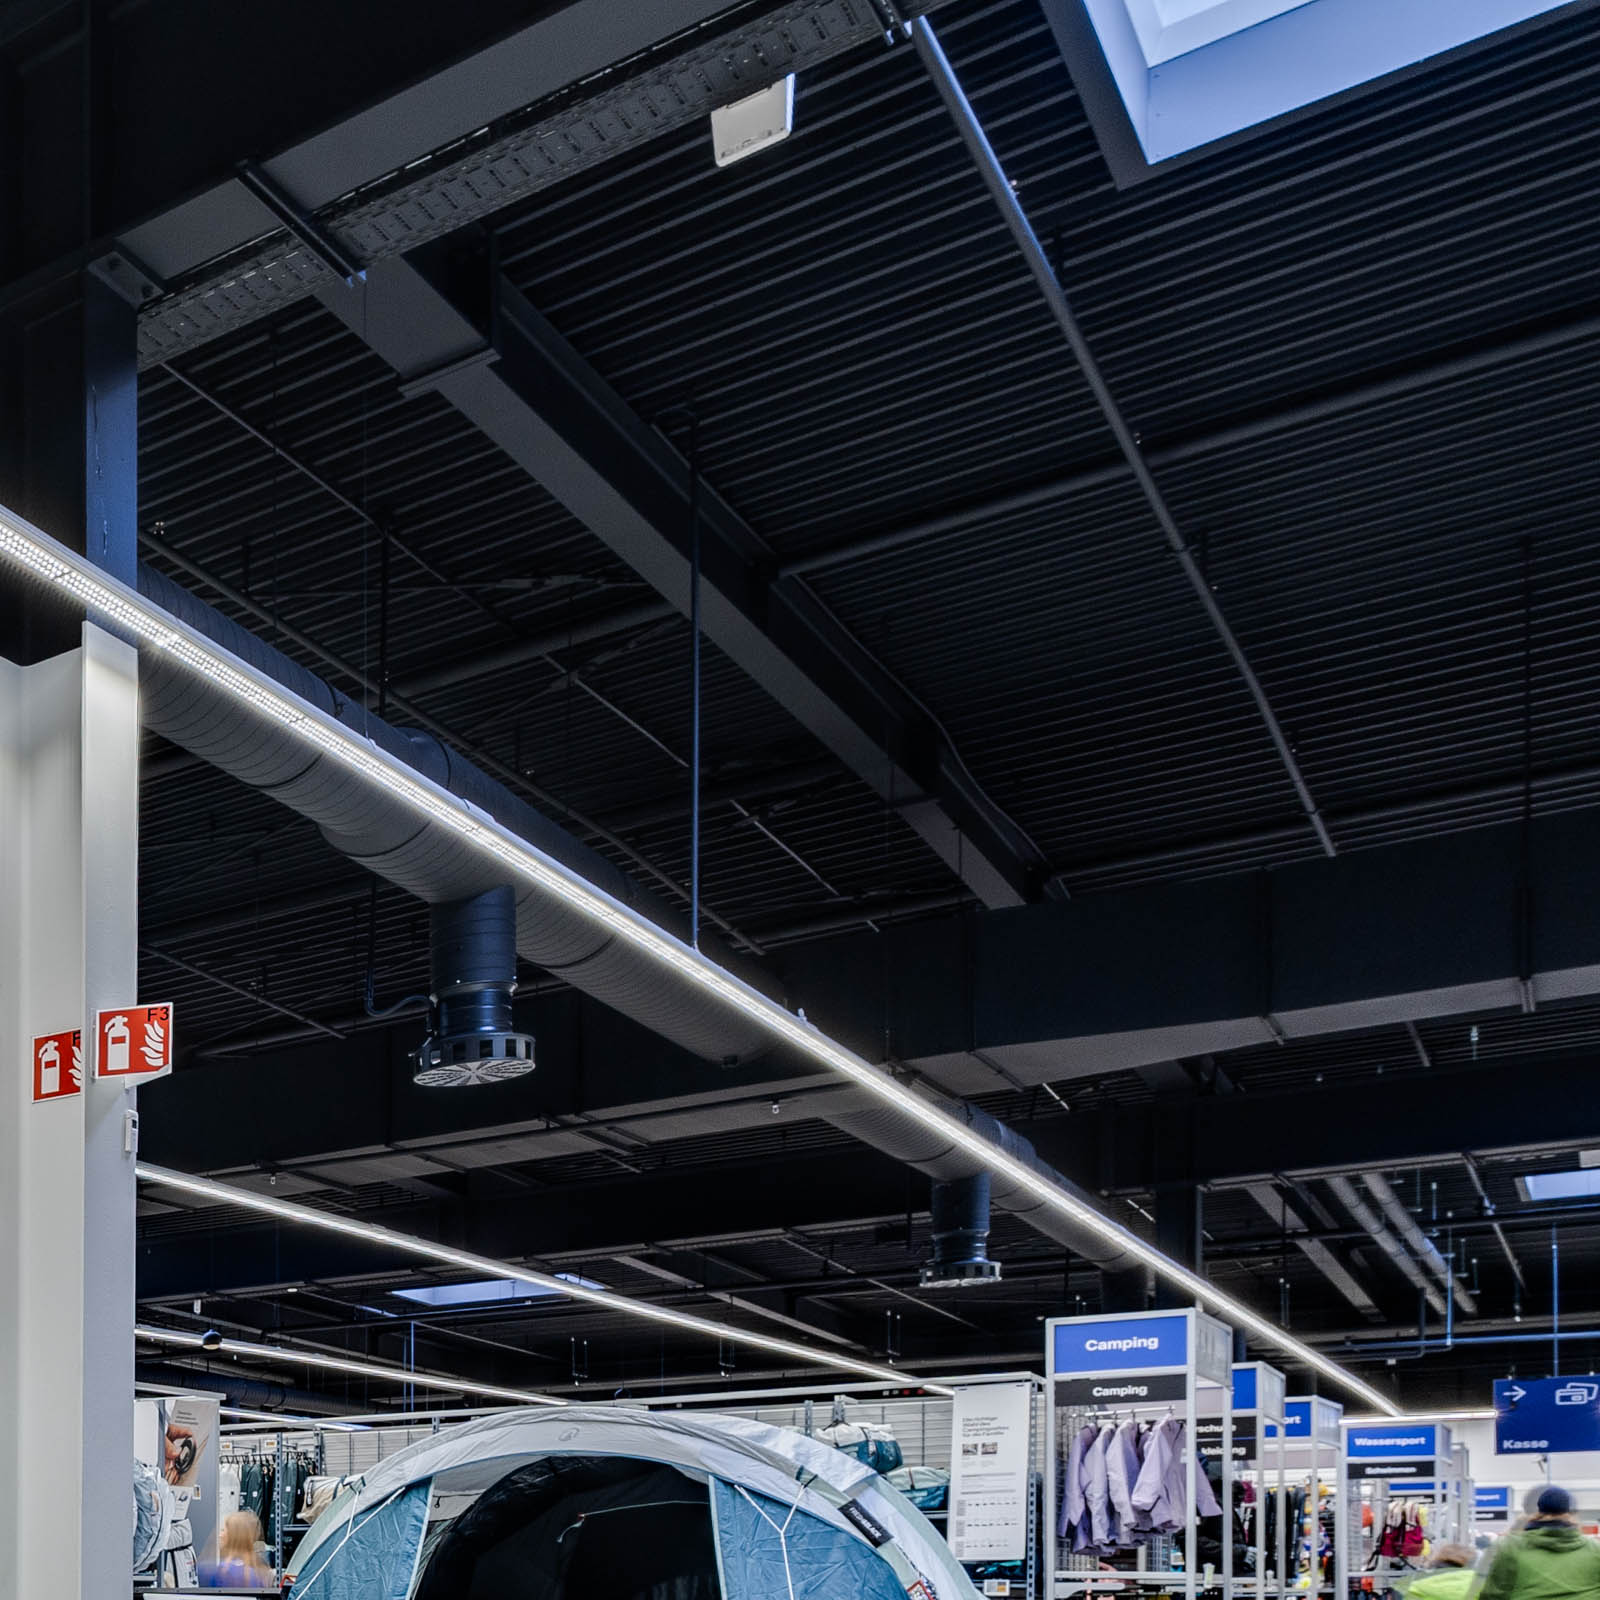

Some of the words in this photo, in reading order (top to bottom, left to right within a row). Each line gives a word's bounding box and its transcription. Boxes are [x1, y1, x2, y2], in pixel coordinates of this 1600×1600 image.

[1085, 1336, 1159, 1351] Camping
[1092, 1385, 1148, 1397] Camping
[1354, 1437, 1426, 1446] Wassersport
[1503, 1440, 1548, 1449] Kasse
